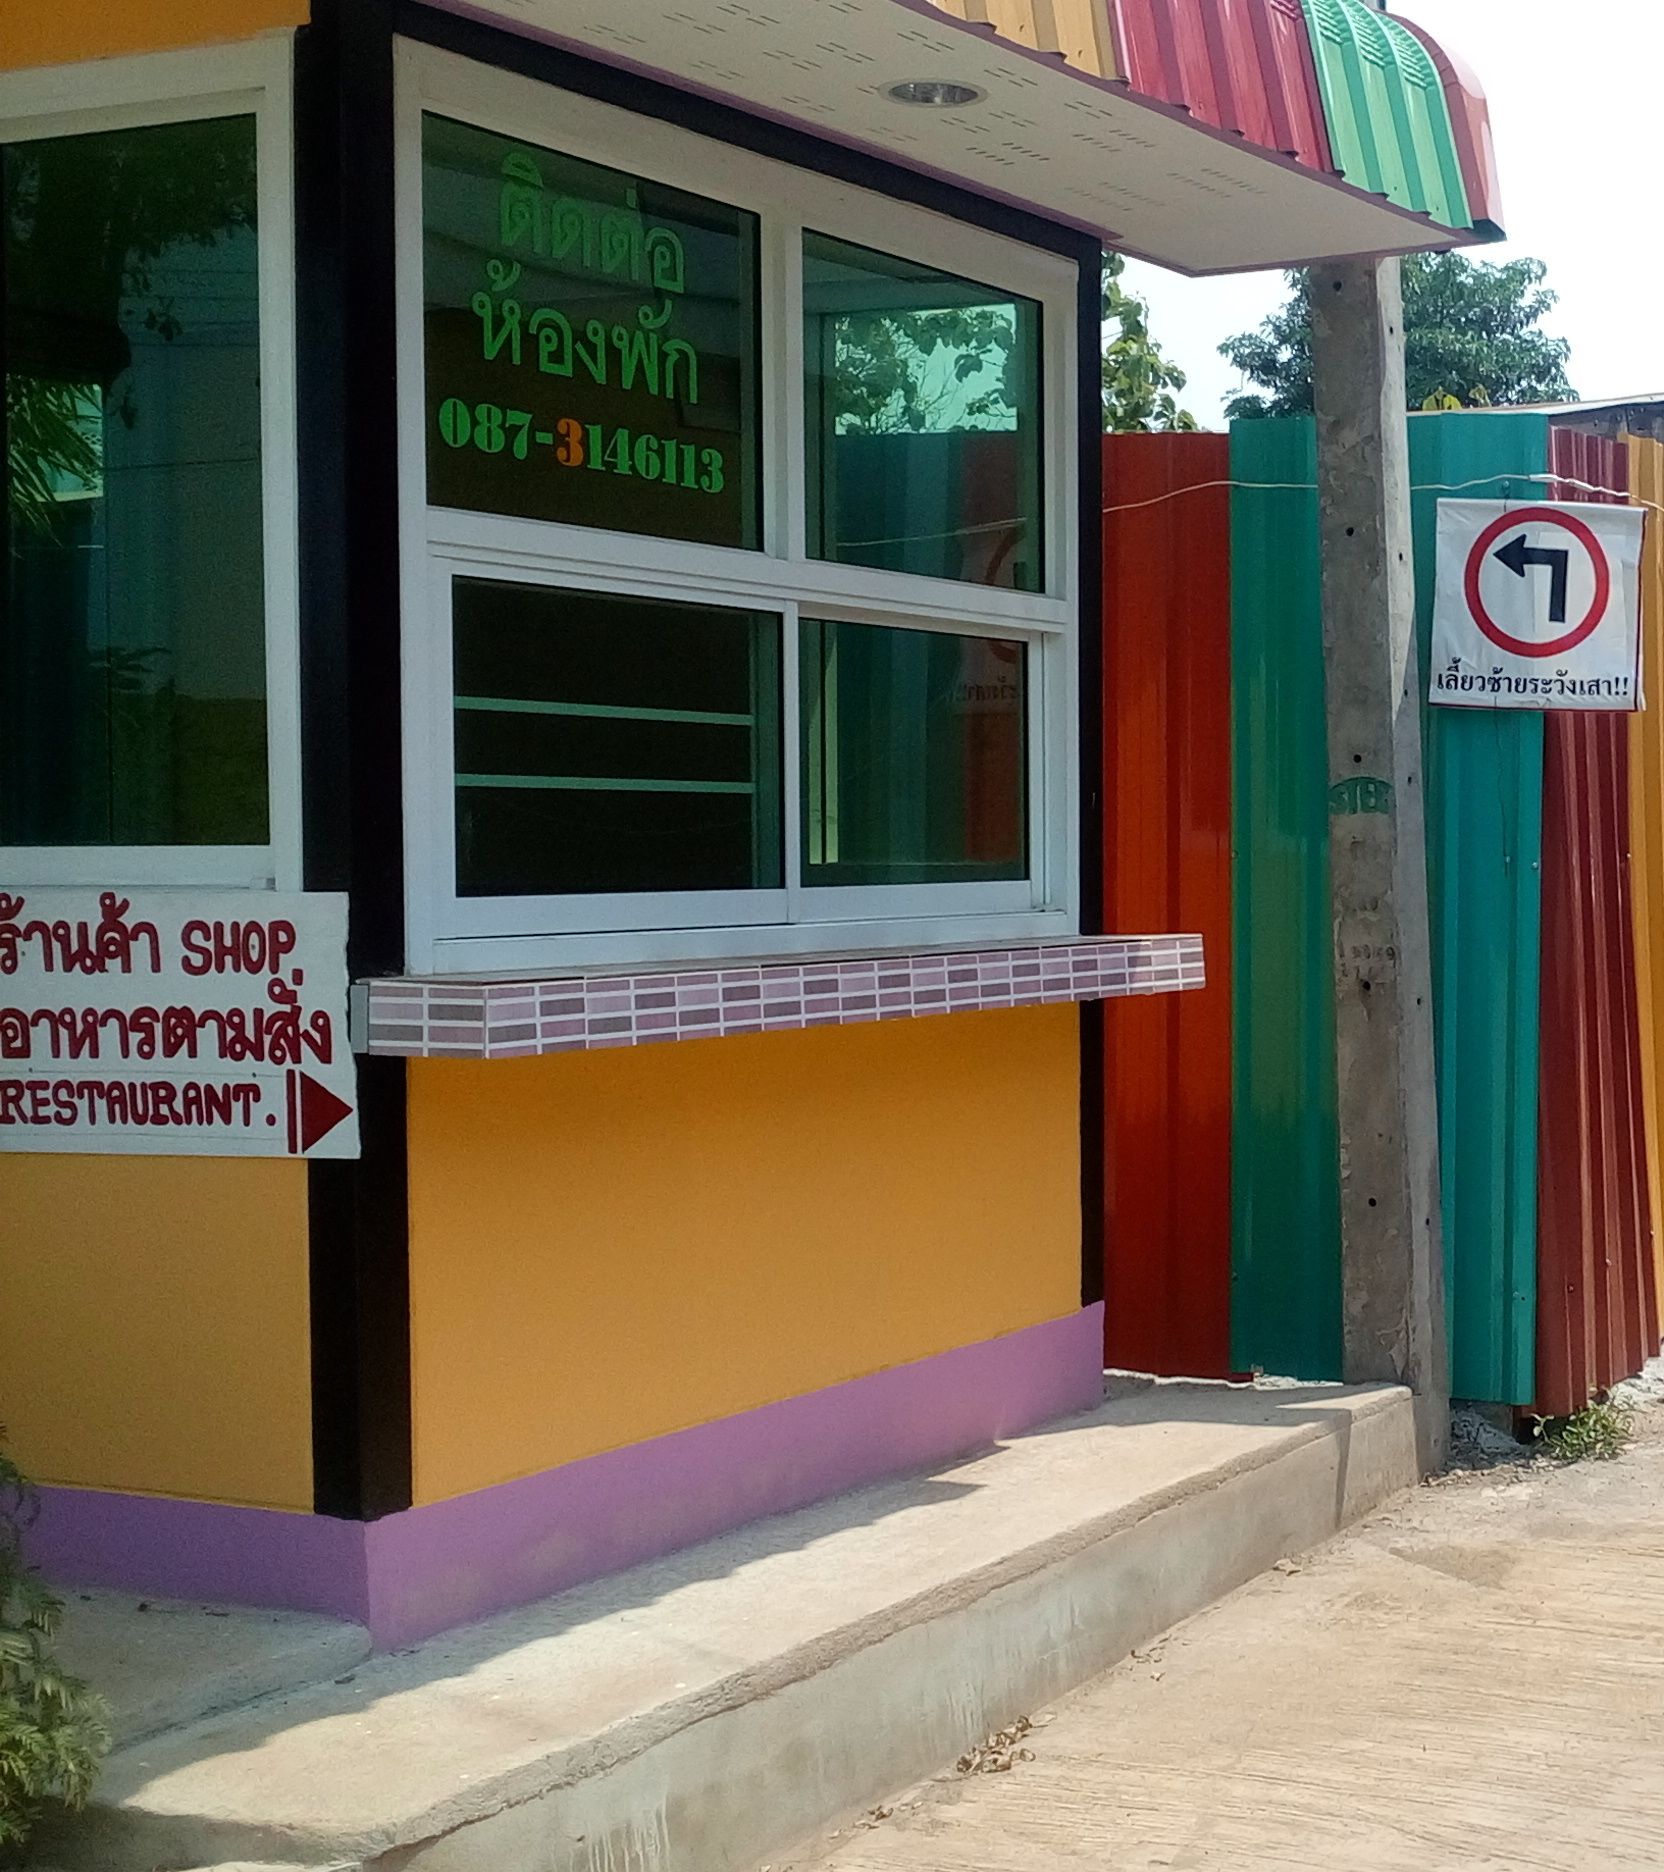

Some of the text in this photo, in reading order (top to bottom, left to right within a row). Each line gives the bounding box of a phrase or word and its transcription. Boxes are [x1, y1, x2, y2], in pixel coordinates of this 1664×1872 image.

[500, 151, 686, 293] ติดต่อ
[471, 257, 699, 406] ห้องพัก
[439, 398, 725, 494] 087-3146113
